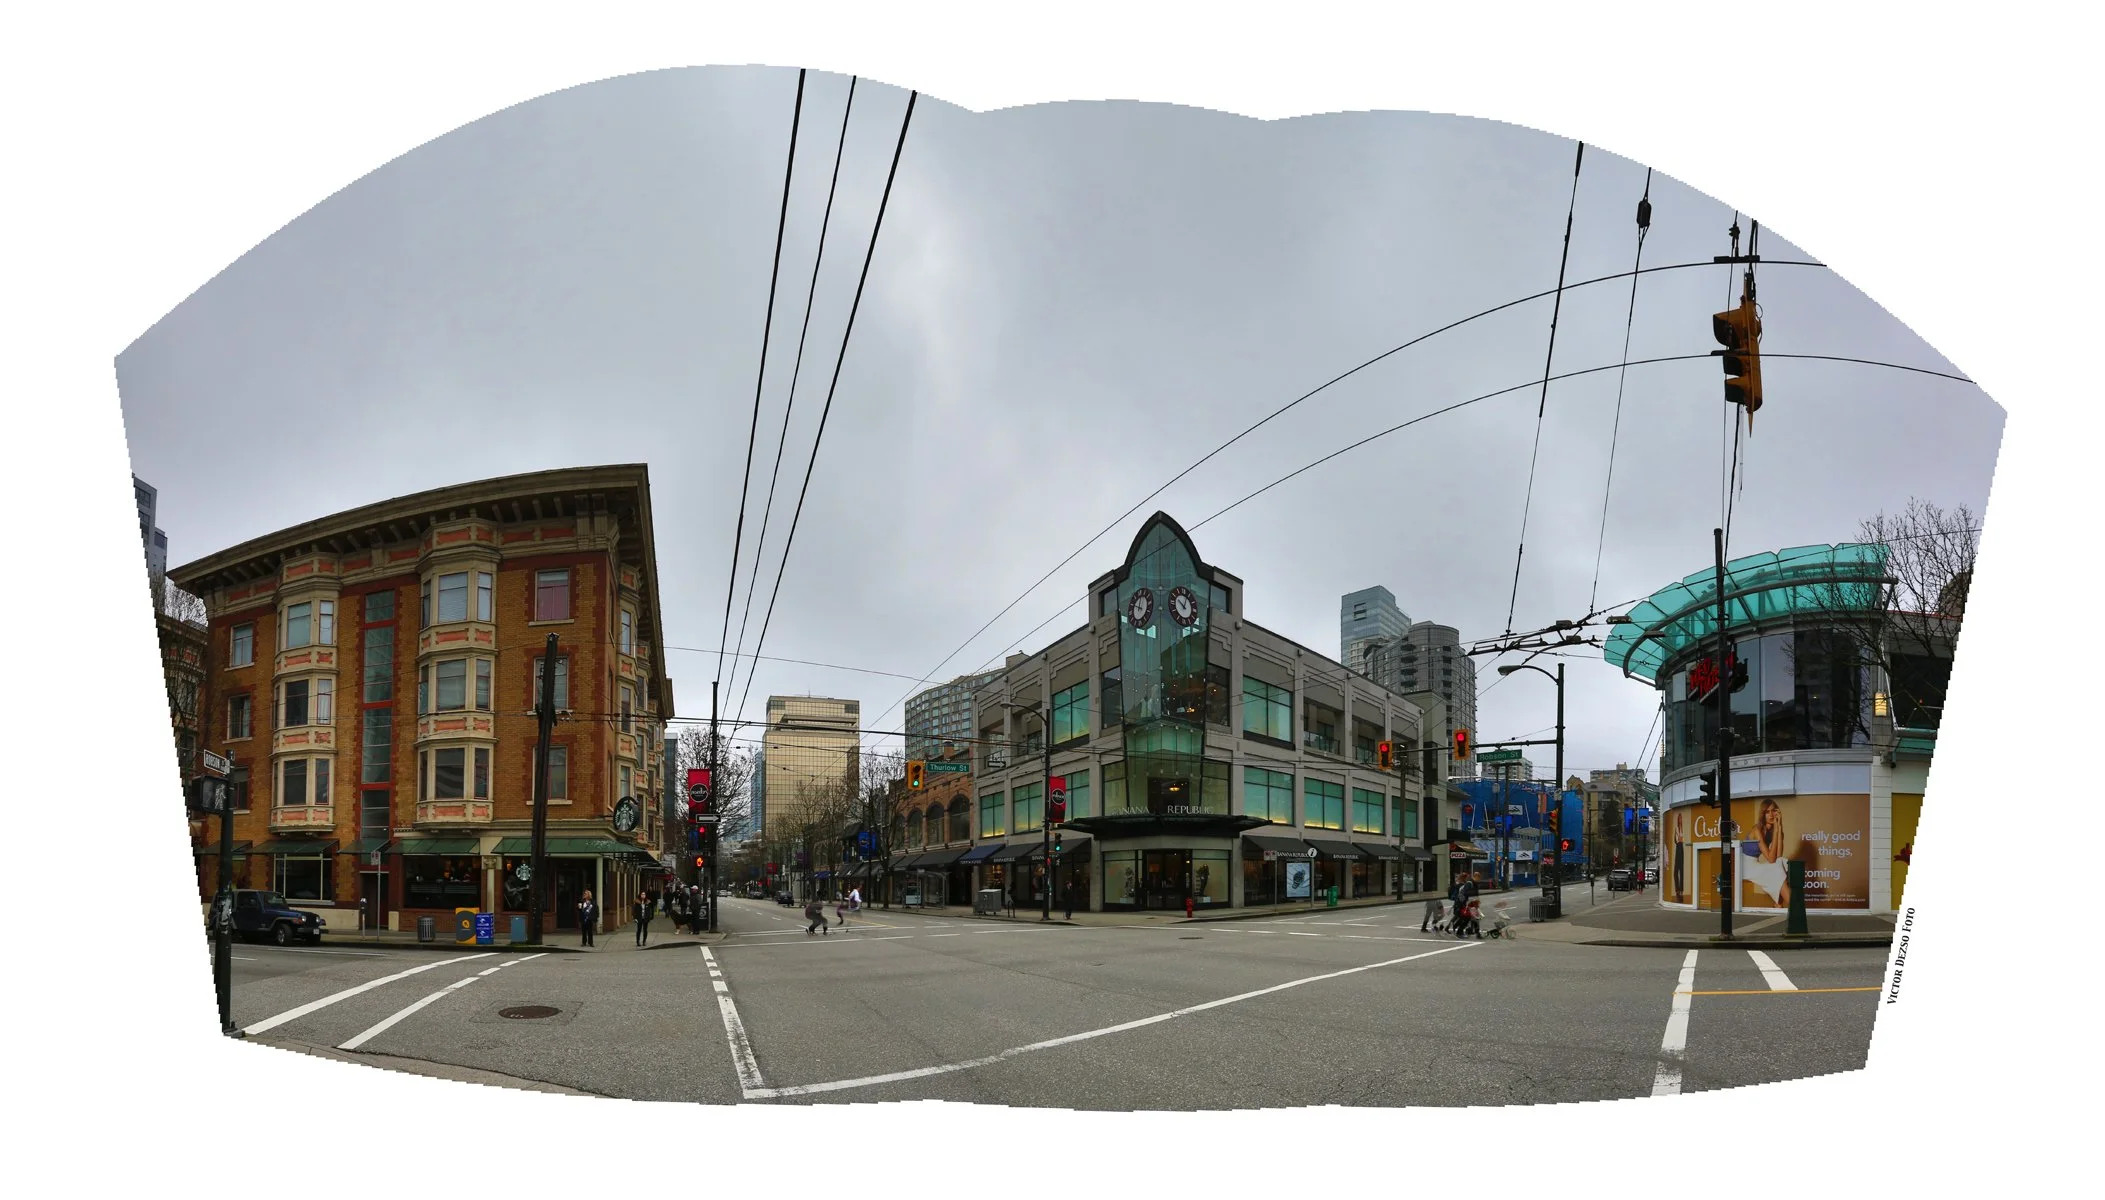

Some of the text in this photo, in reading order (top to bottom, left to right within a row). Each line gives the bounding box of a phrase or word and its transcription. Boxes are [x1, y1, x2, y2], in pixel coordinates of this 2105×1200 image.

[1480, 753, 1507, 761] Robson
[930, 763, 957, 771] Thurlow
[1801, 830, 1861, 843] really good
[1818, 845, 1853, 858] things,
